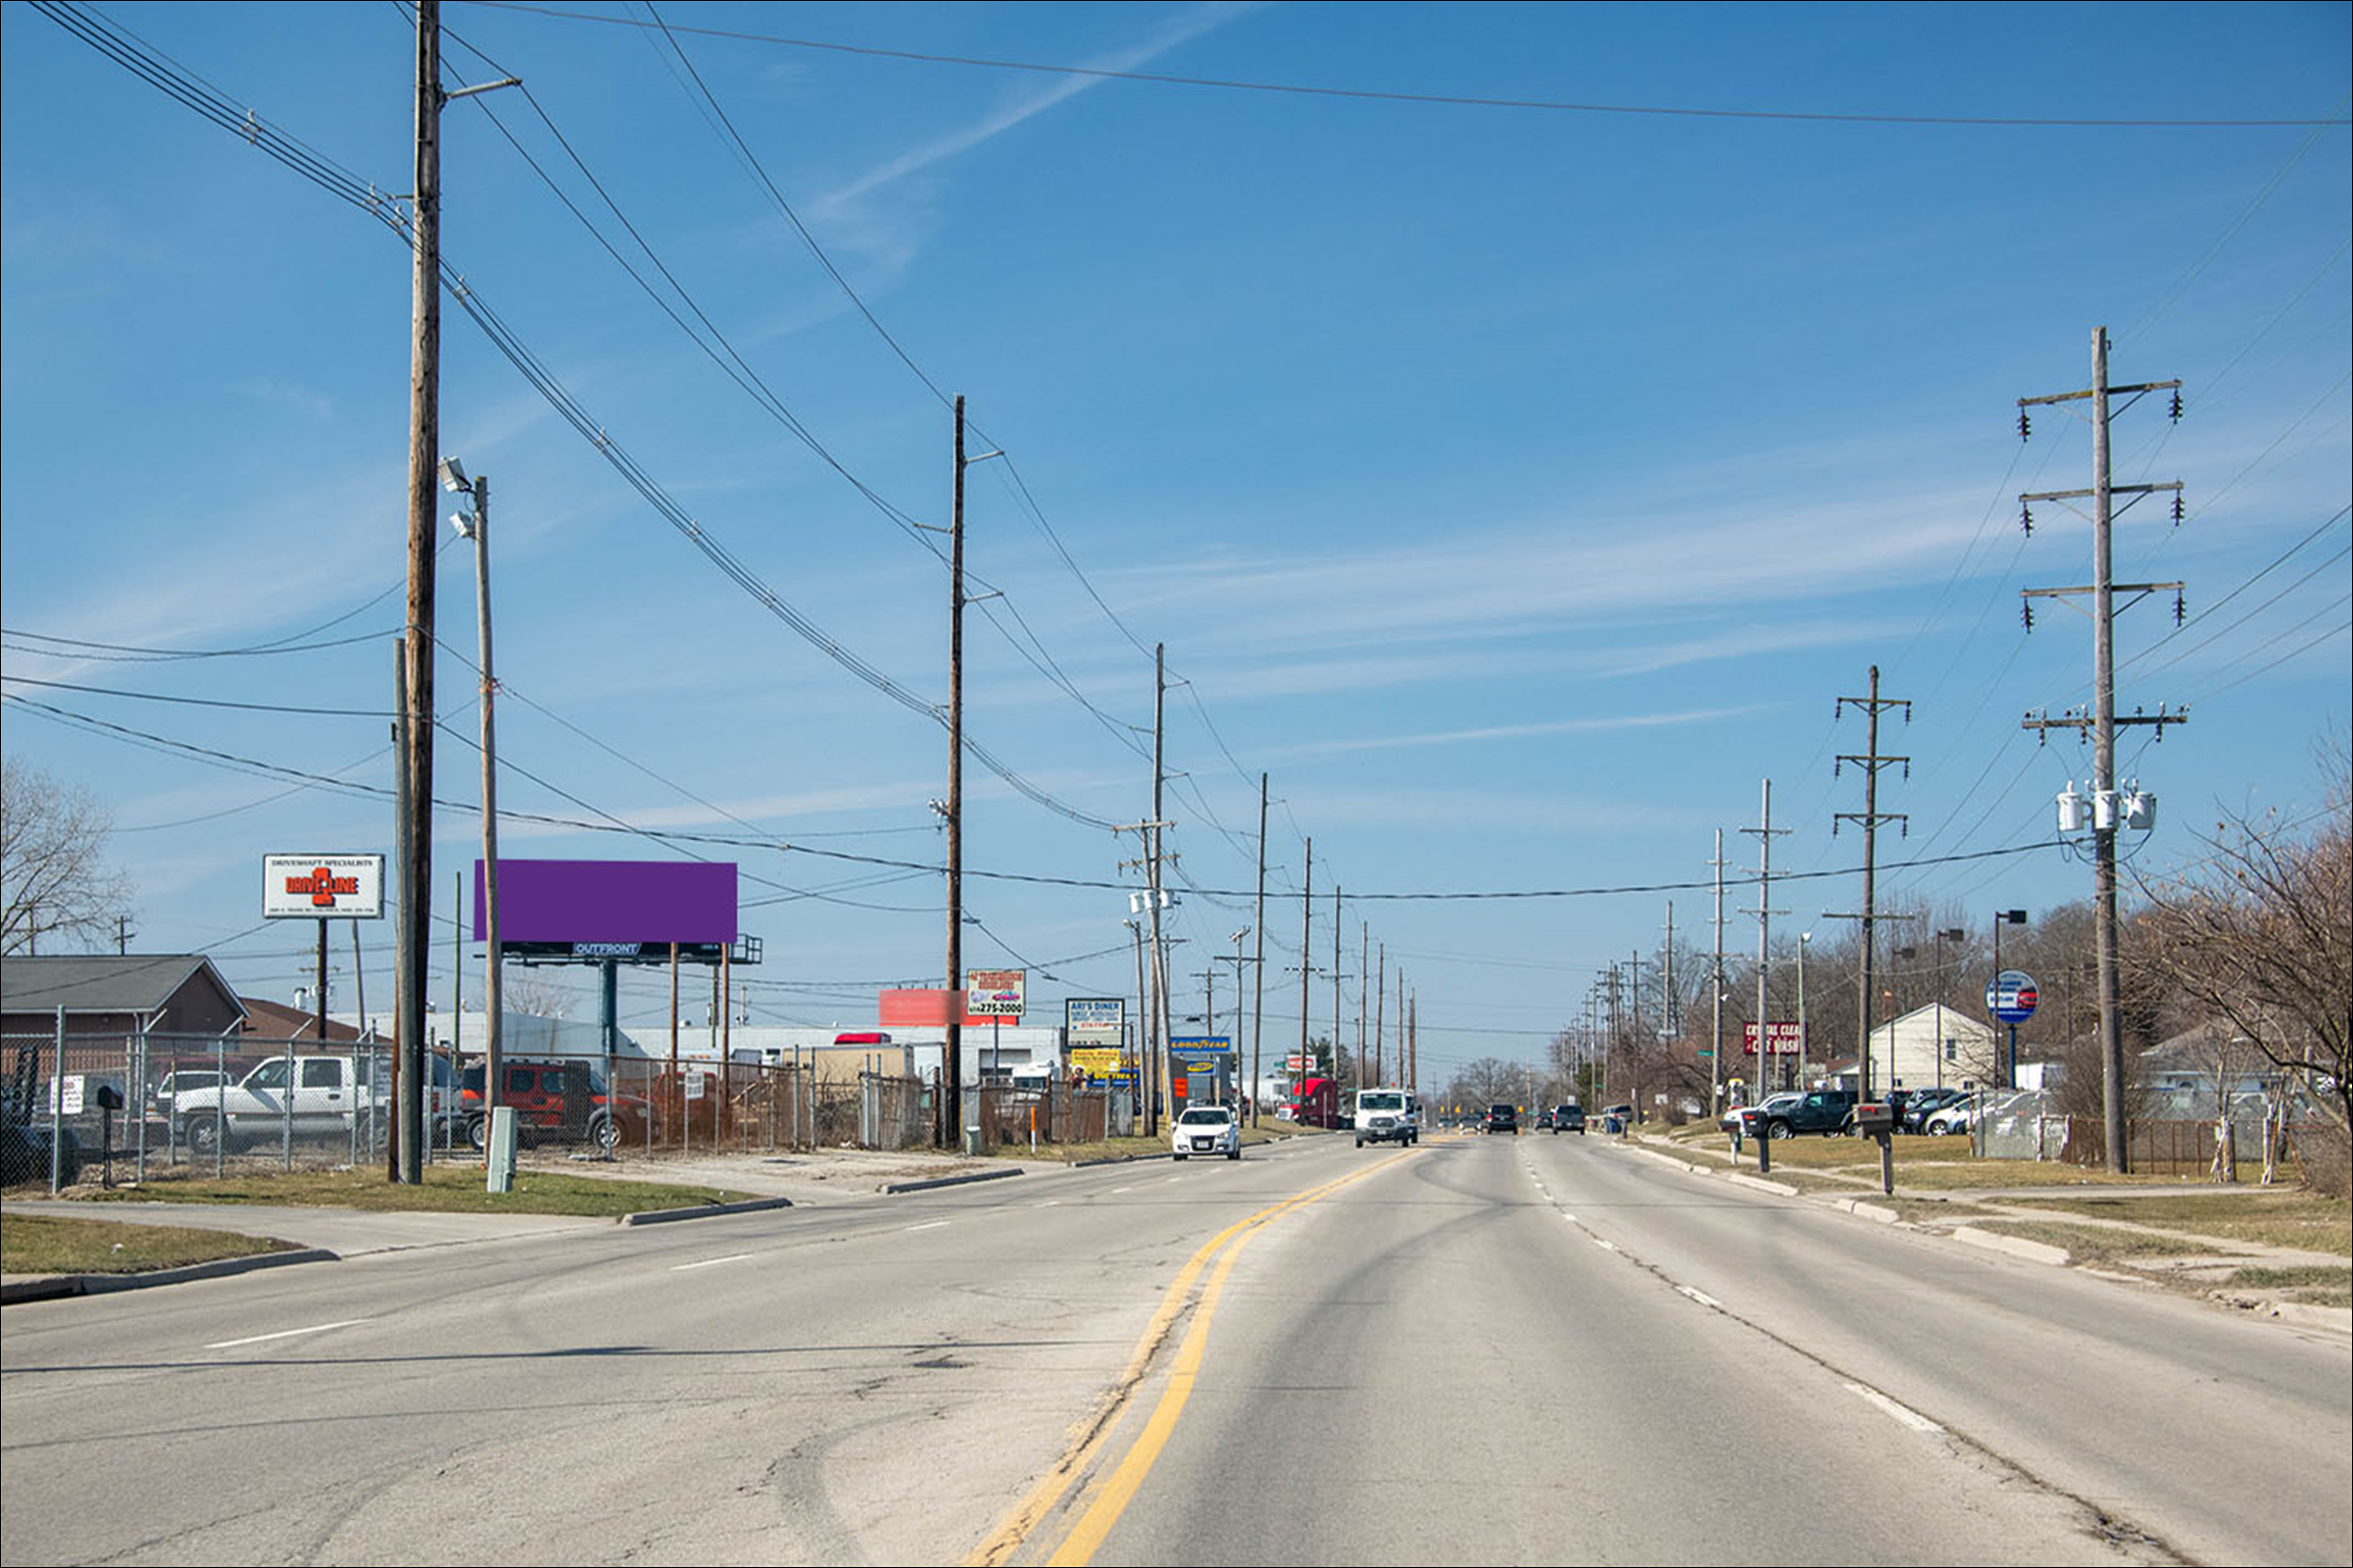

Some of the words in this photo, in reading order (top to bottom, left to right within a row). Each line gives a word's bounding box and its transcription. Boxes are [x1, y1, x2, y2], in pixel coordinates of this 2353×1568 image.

[285, 876, 322, 894] DRIVE
[575, 942, 637, 955] OUTFRONT
[980, 1003, 1023, 1012] 275-2000
[1746, 1024, 1779, 1036] CRTAL
[1781, 1024, 1800, 1036] CLEA
[1170, 1040, 1228, 1050] GOODYEAR
[1752, 1040, 1772, 1053] CR
[1774, 1040, 1799, 1053] WASH
